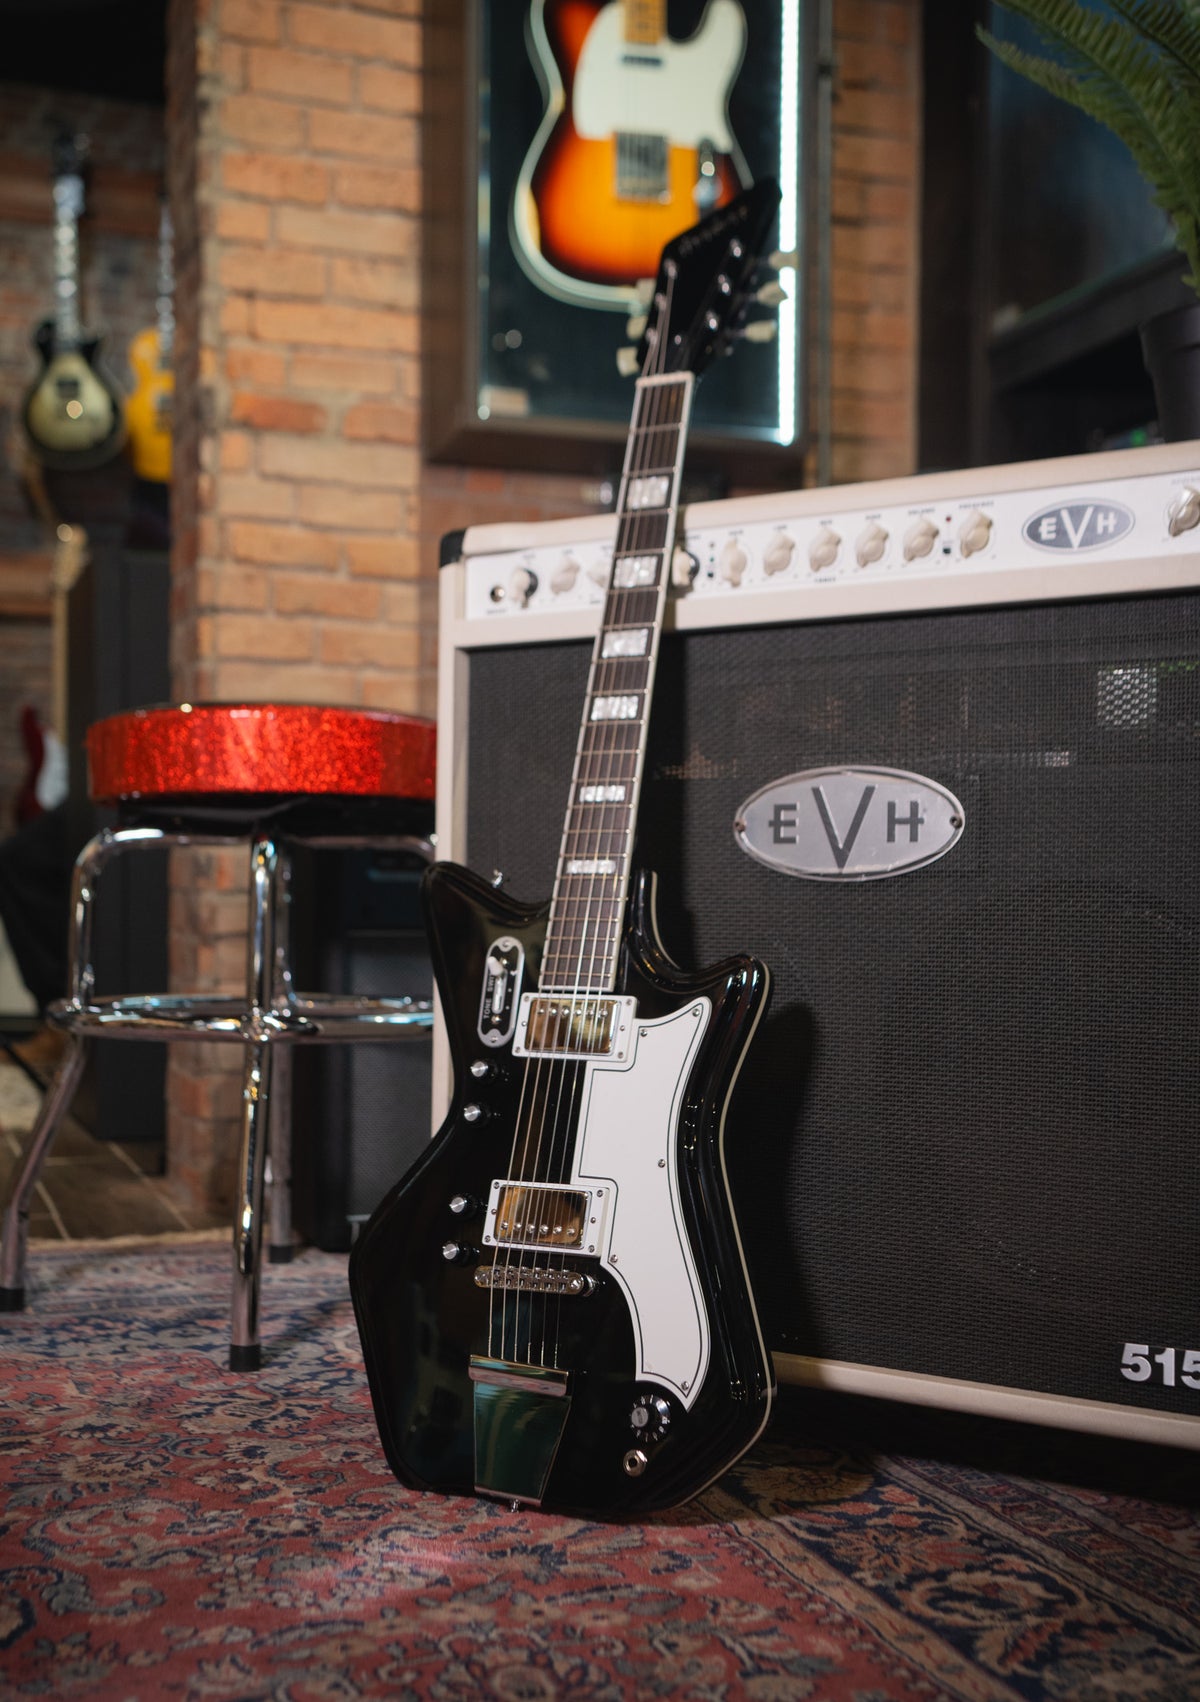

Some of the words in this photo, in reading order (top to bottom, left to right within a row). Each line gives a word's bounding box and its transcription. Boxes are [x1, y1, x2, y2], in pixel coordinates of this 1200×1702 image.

[1038, 506, 1117, 550] EVH
[768, 784, 925, 873] EVH
[483, 998, 492, 1019] TONE
